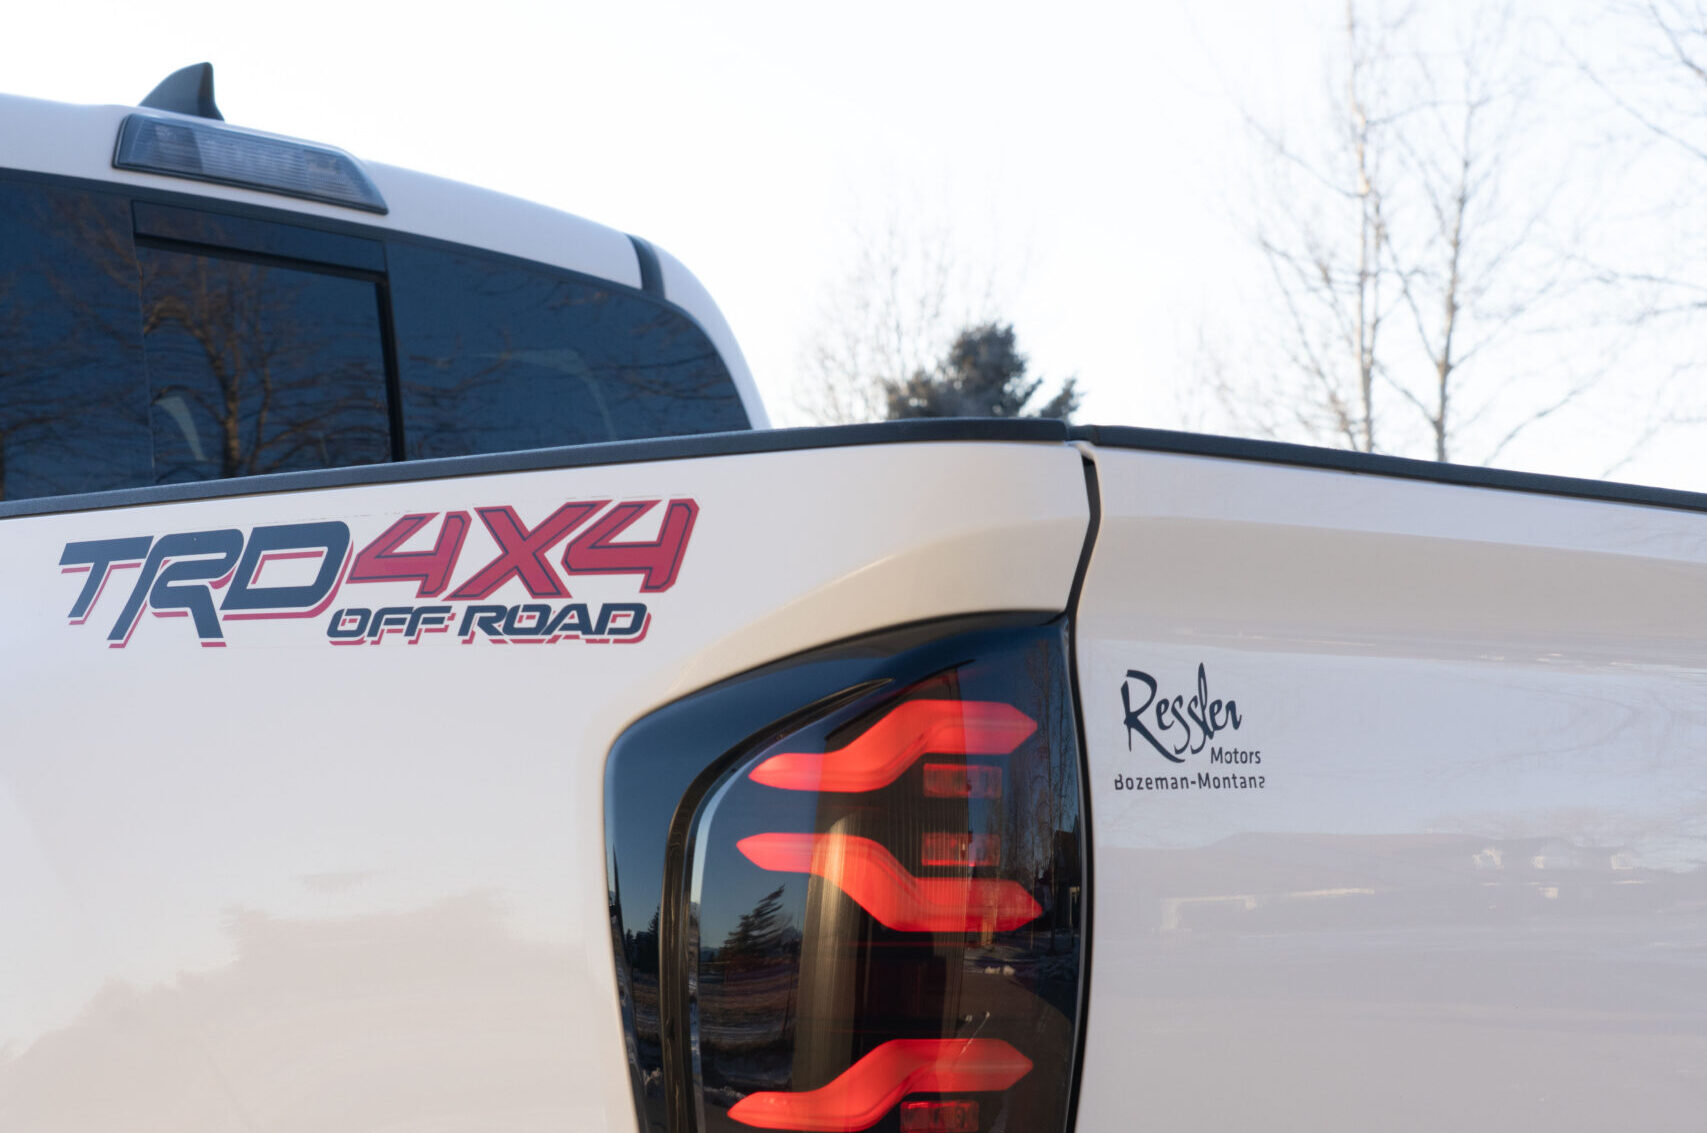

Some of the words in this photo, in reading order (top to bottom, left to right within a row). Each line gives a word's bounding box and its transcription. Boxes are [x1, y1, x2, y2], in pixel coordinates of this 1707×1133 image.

[59, 520, 352, 648] TRD
[346, 498, 700, 601] 4X4
[326, 605, 454, 646] OFF
[457, 602, 652, 645] ROAD
[1120, 662, 1242, 763] Ressler
[1210, 747, 1261, 764] Motors
